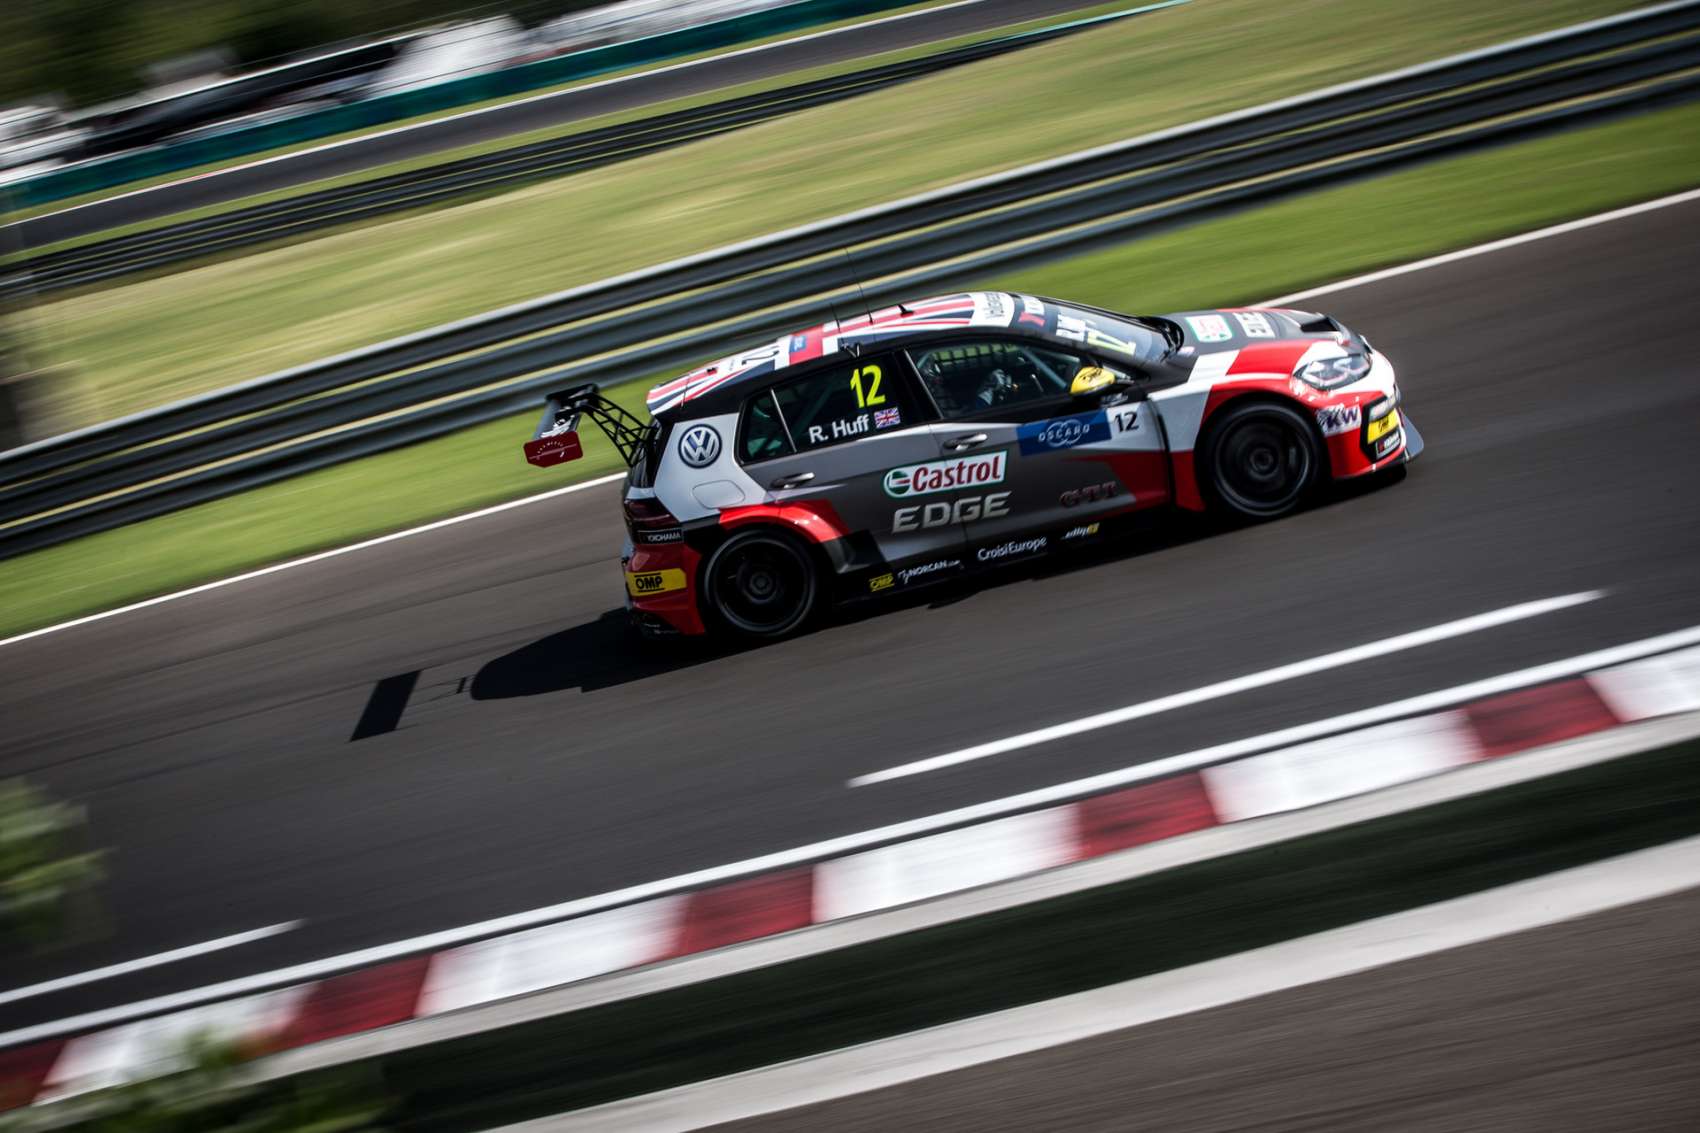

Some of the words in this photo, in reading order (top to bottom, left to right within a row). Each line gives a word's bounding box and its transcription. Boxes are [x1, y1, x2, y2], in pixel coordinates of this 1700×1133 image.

[850, 364, 886, 409] 12
[808, 425, 829, 444] R.
[832, 414, 870, 439] Huff
[1114, 411, 1139, 433] 12
[1326, 406, 1358, 430] KW
[912, 455, 1001, 493] Castrol
[891, 490, 1012, 535] EDGE
[977, 535, 1048, 562] CroisiEurope
[635, 575, 663, 590] OMP
